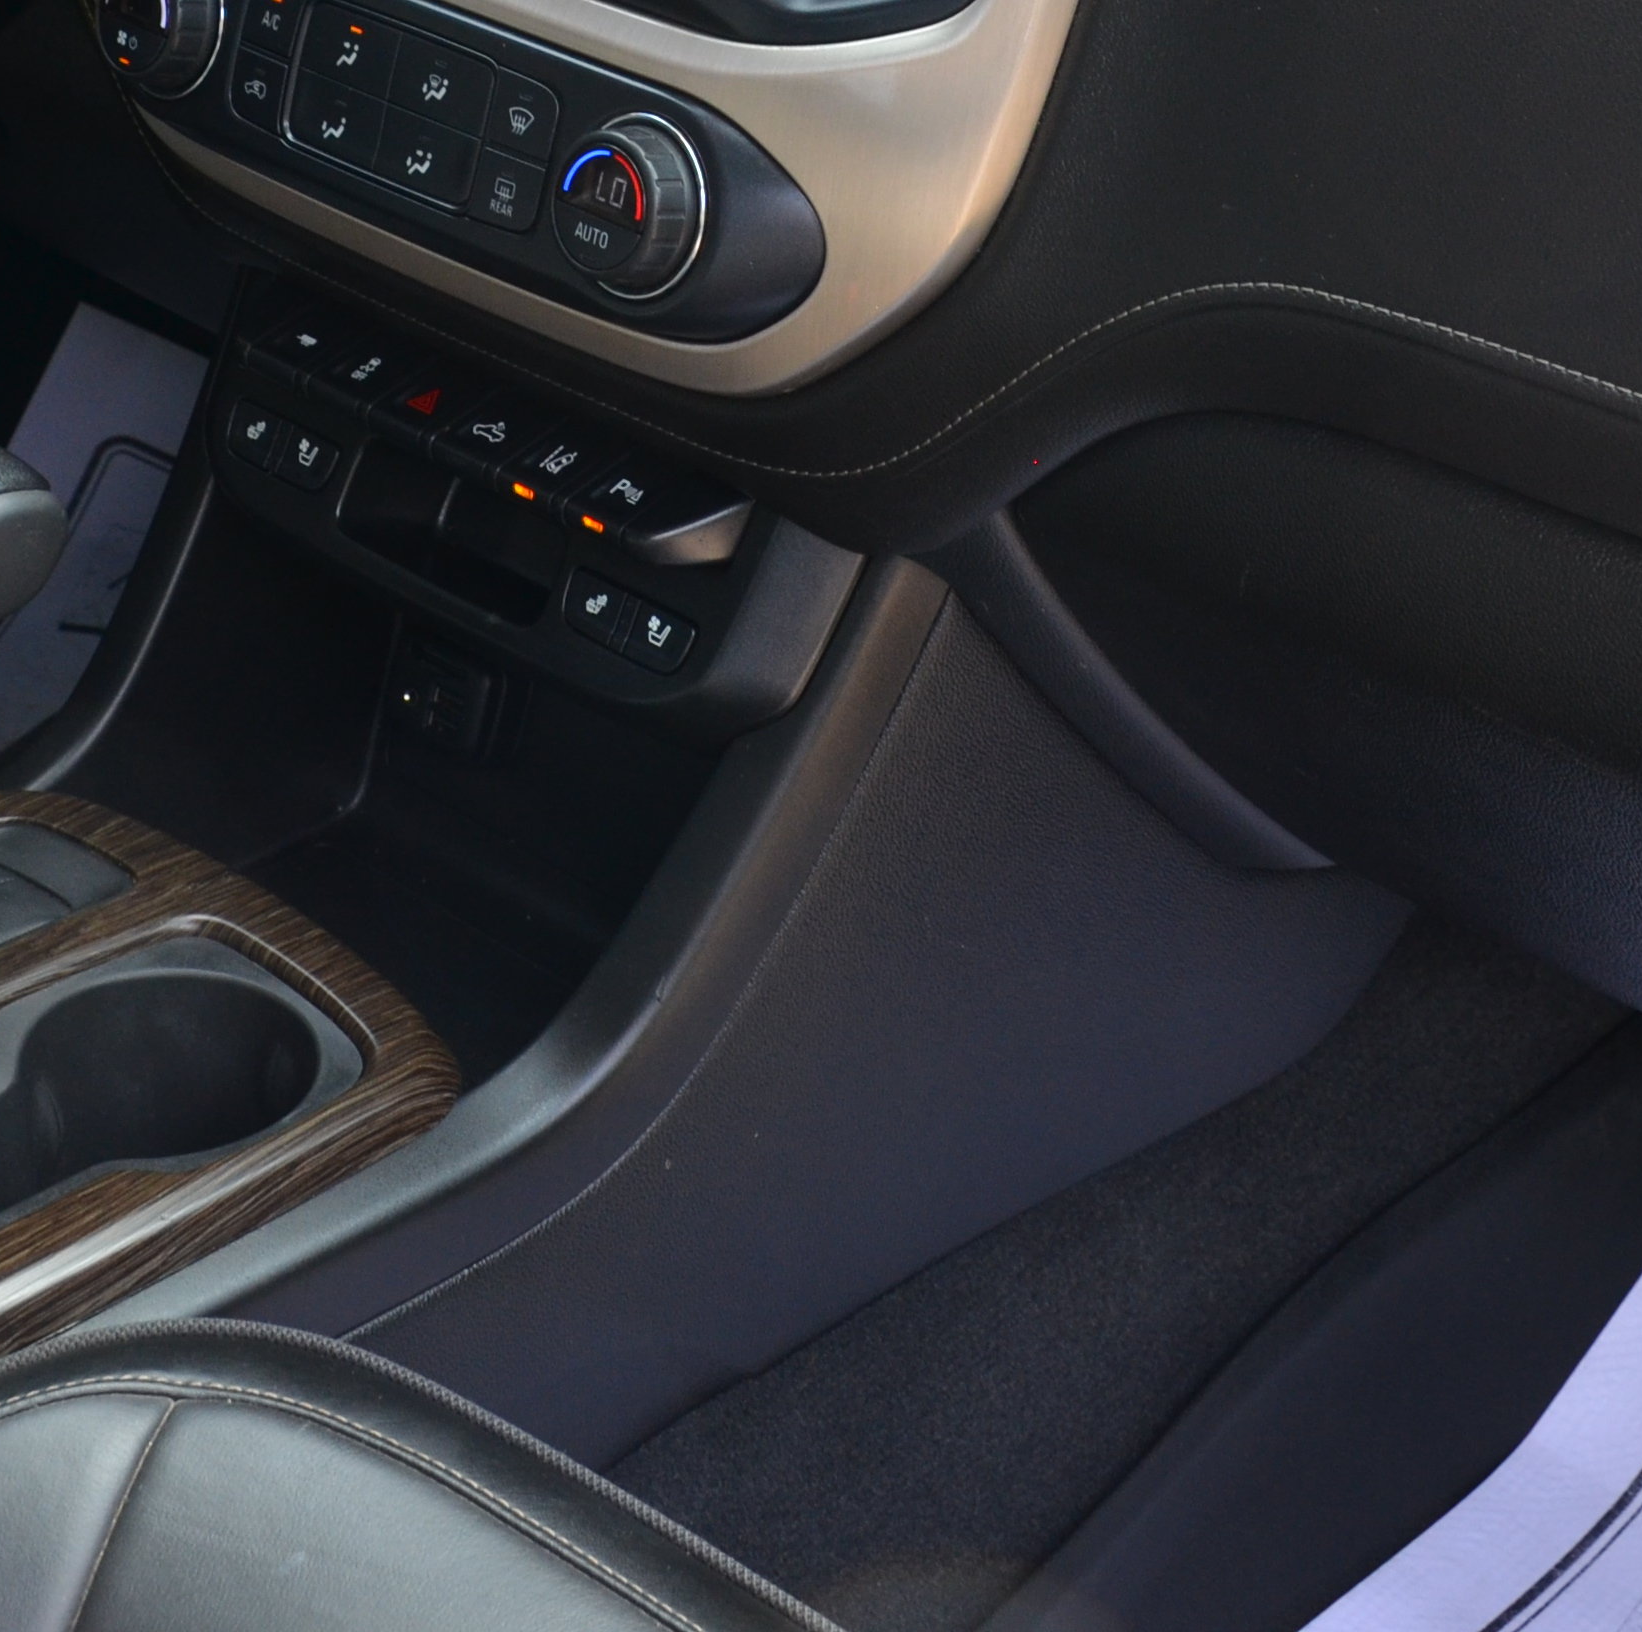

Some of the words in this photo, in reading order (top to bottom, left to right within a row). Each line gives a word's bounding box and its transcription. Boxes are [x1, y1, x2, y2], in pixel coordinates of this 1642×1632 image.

[262, 11, 281, 31] A/C
[489, 199, 513, 218] REAR
[575, 221, 609, 249] AUTO
